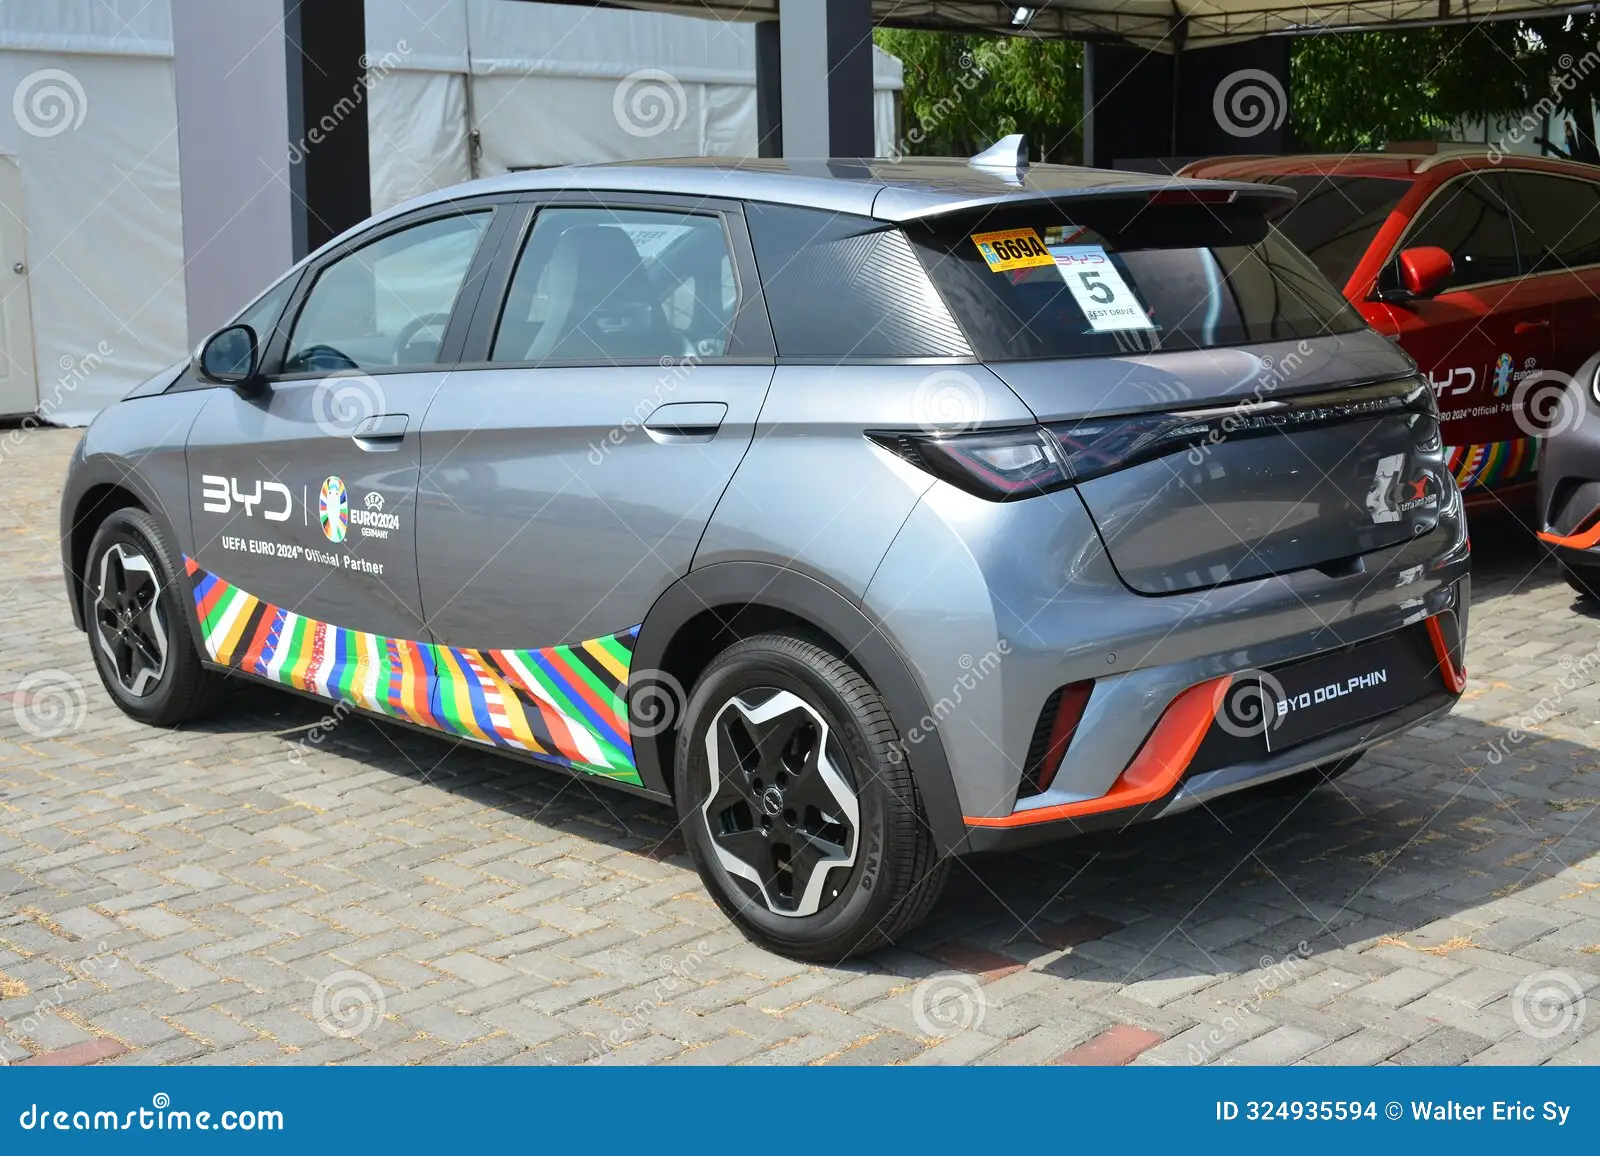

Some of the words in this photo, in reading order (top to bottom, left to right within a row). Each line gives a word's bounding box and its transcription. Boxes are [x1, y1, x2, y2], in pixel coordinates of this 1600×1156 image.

[991, 236, 1049, 261] 669A
[1077, 271, 1115, 304] 5
[1087, 309, 1108, 318] TEST
[1109, 307, 1136, 316] DRIVE
[1421, 366, 1476, 398] YD
[1472, 404, 1498, 417] Official
[202, 474, 292, 522] BYD
[350, 509, 400, 530] EURO2024
[361, 526, 389, 540] GERMANY
[222, 535, 248, 552] UEFA
[249, 539, 276, 556] EURO
[304, 547, 340, 568] Official
[343, 555, 384, 575] Partner
[1276, 692, 1311, 717] BYD
[1314, 669, 1387, 704] DOLPHIN
